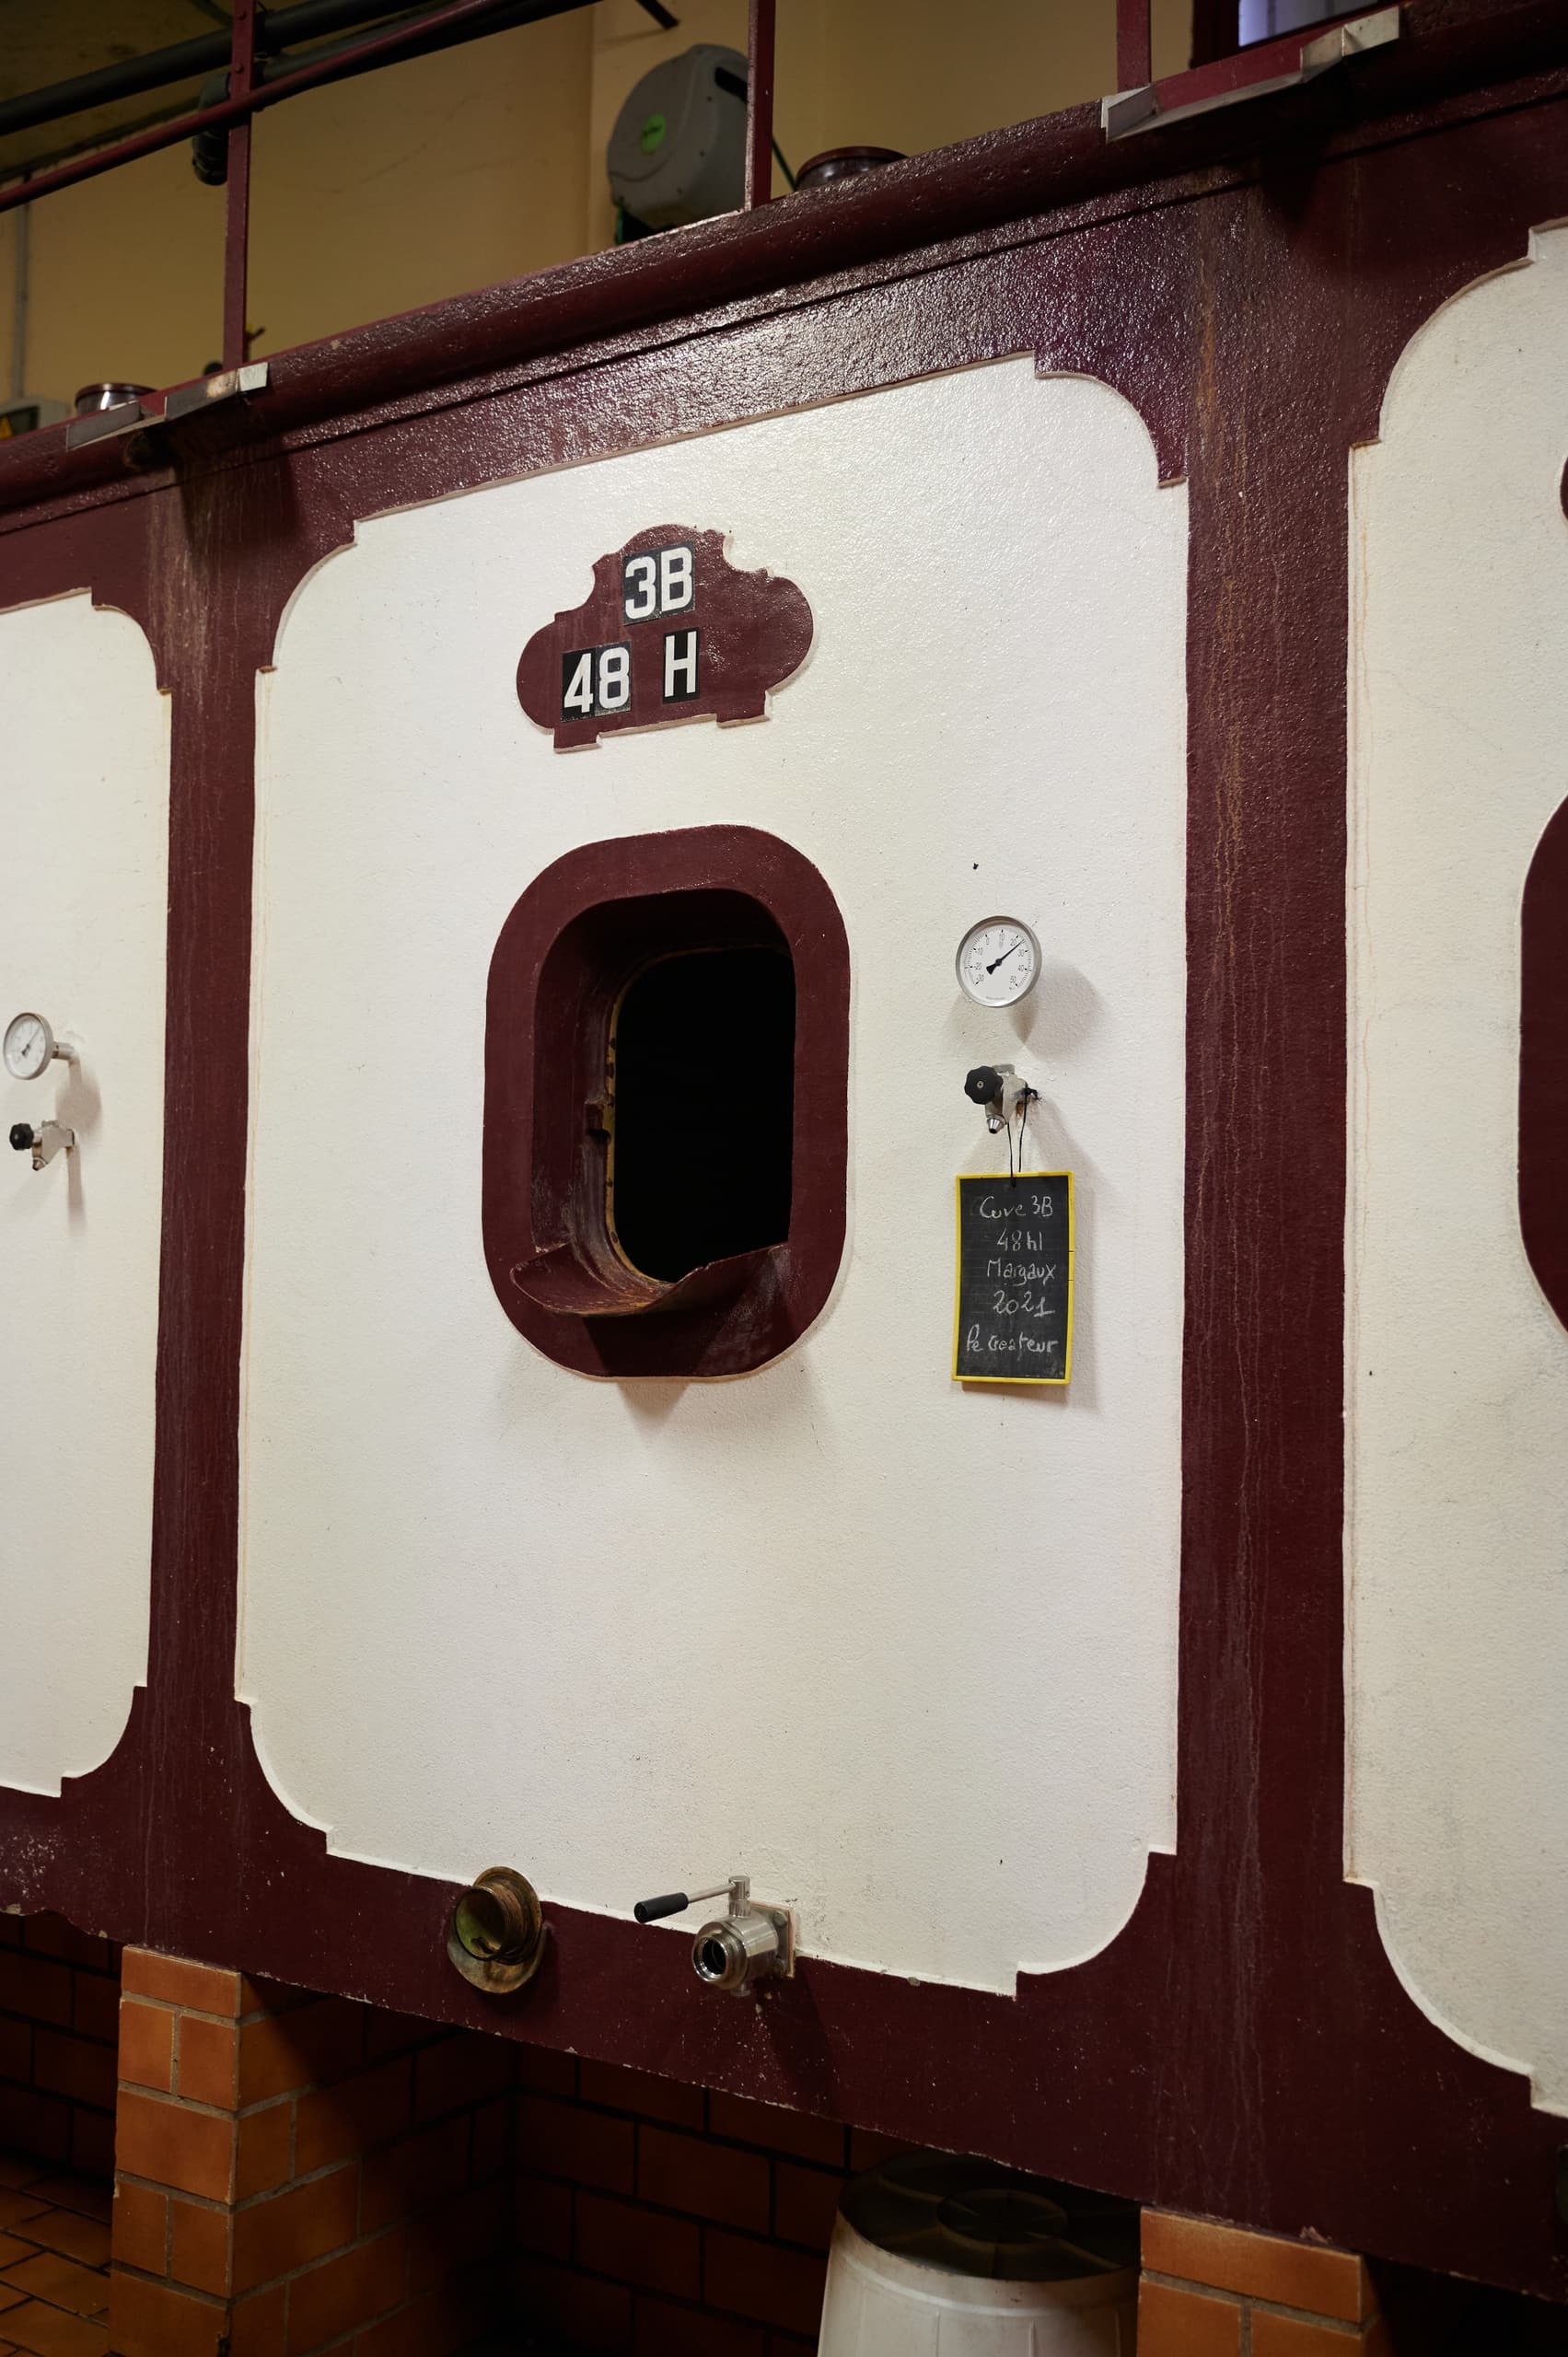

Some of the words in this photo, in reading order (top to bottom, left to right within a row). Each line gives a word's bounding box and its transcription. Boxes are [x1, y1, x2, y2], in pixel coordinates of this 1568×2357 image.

[624, 546, 692, 620] 3B
[563, 646, 631, 714] 48
[664, 631, 697, 698] H
[980, 1195, 1027, 1219] Cuve
[1031, 1194, 1053, 1217] 3B
[987, 1257, 1056, 1286] Margaux
[993, 1289, 1056, 1318] 2021
